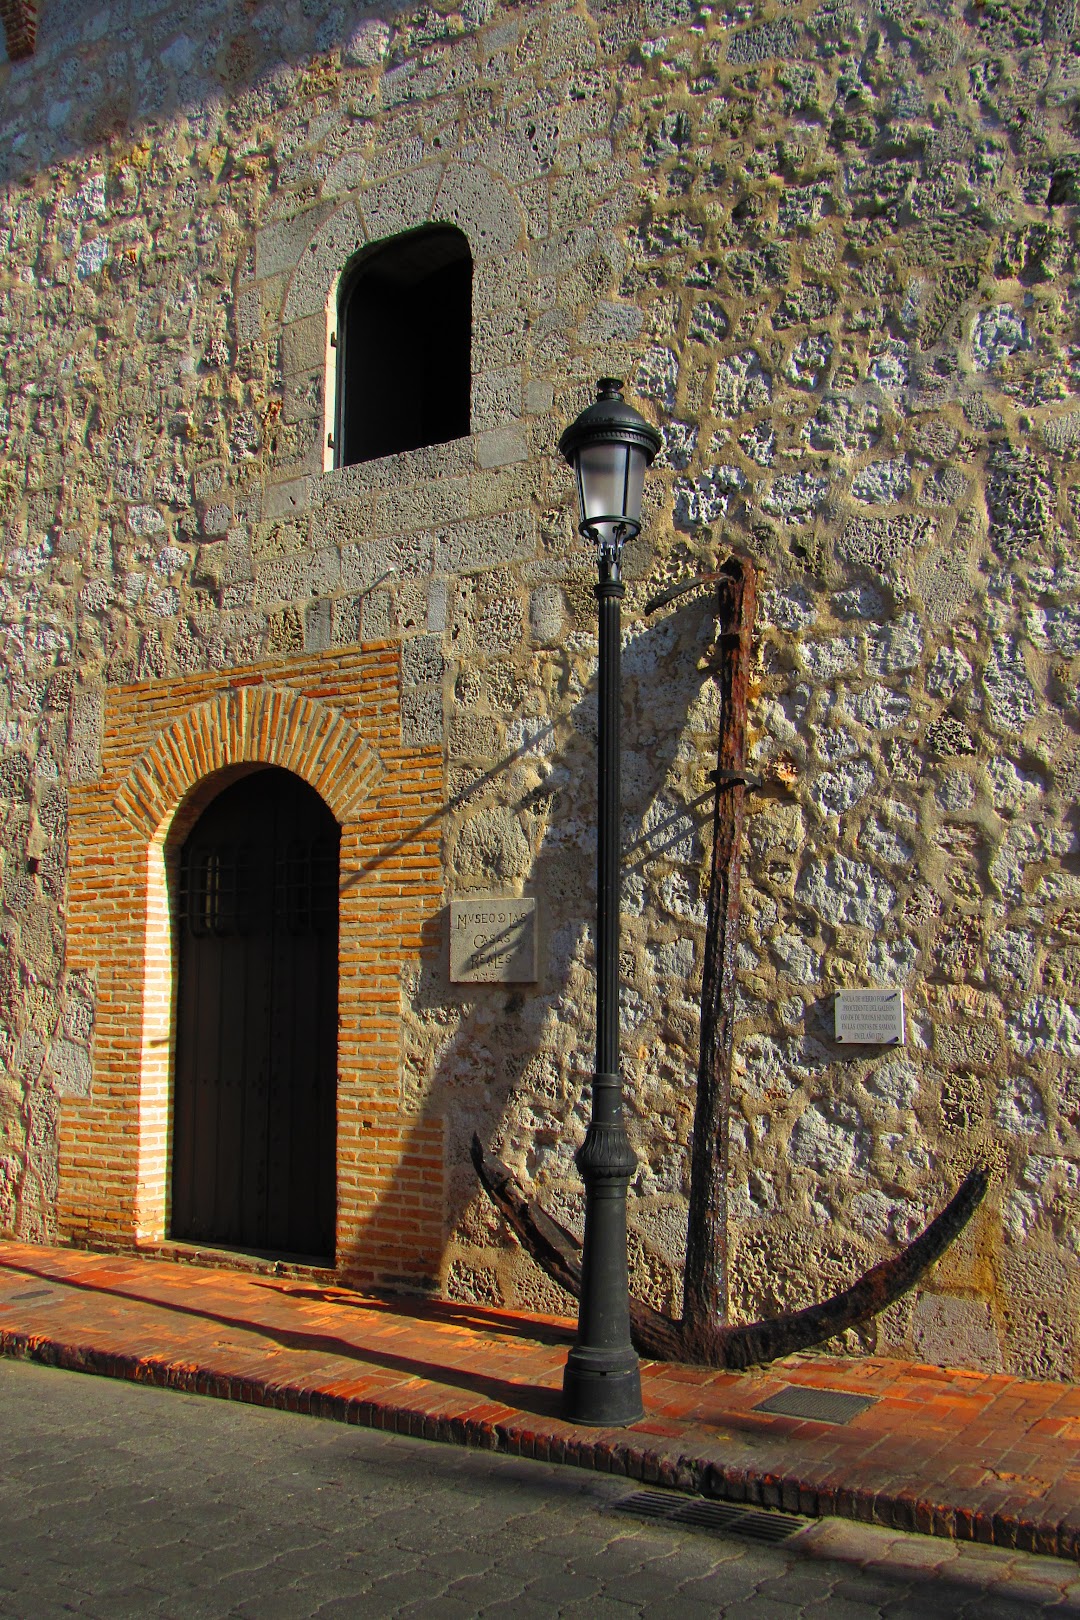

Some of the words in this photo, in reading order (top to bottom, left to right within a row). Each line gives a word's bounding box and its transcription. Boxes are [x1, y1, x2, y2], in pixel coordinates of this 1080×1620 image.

[509, 912, 527, 928] LAS
[474, 933, 511, 949] CASAS
[471, 953, 512, 969] REALES
